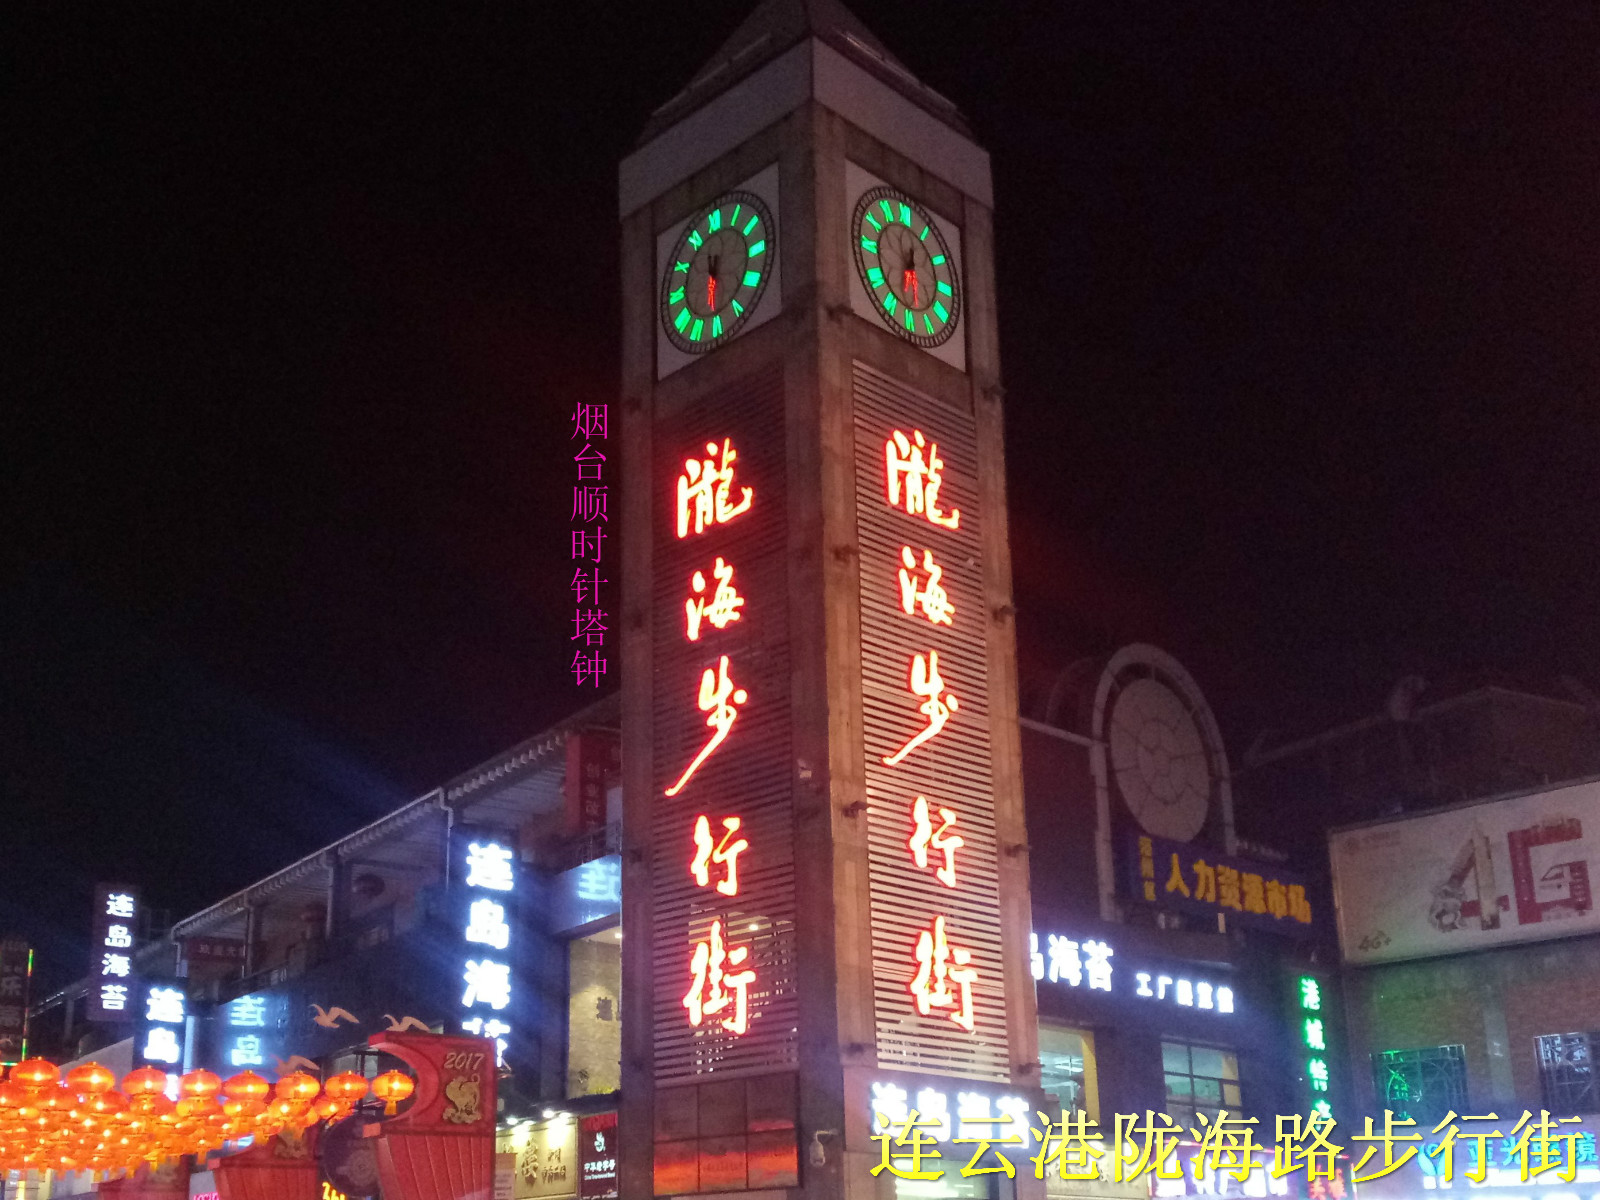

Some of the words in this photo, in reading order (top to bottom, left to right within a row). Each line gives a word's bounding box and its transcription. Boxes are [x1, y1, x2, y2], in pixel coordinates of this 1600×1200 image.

[101, 894, 134, 1010] 连岛海苔
[443, 1051, 485, 1071] 2017
